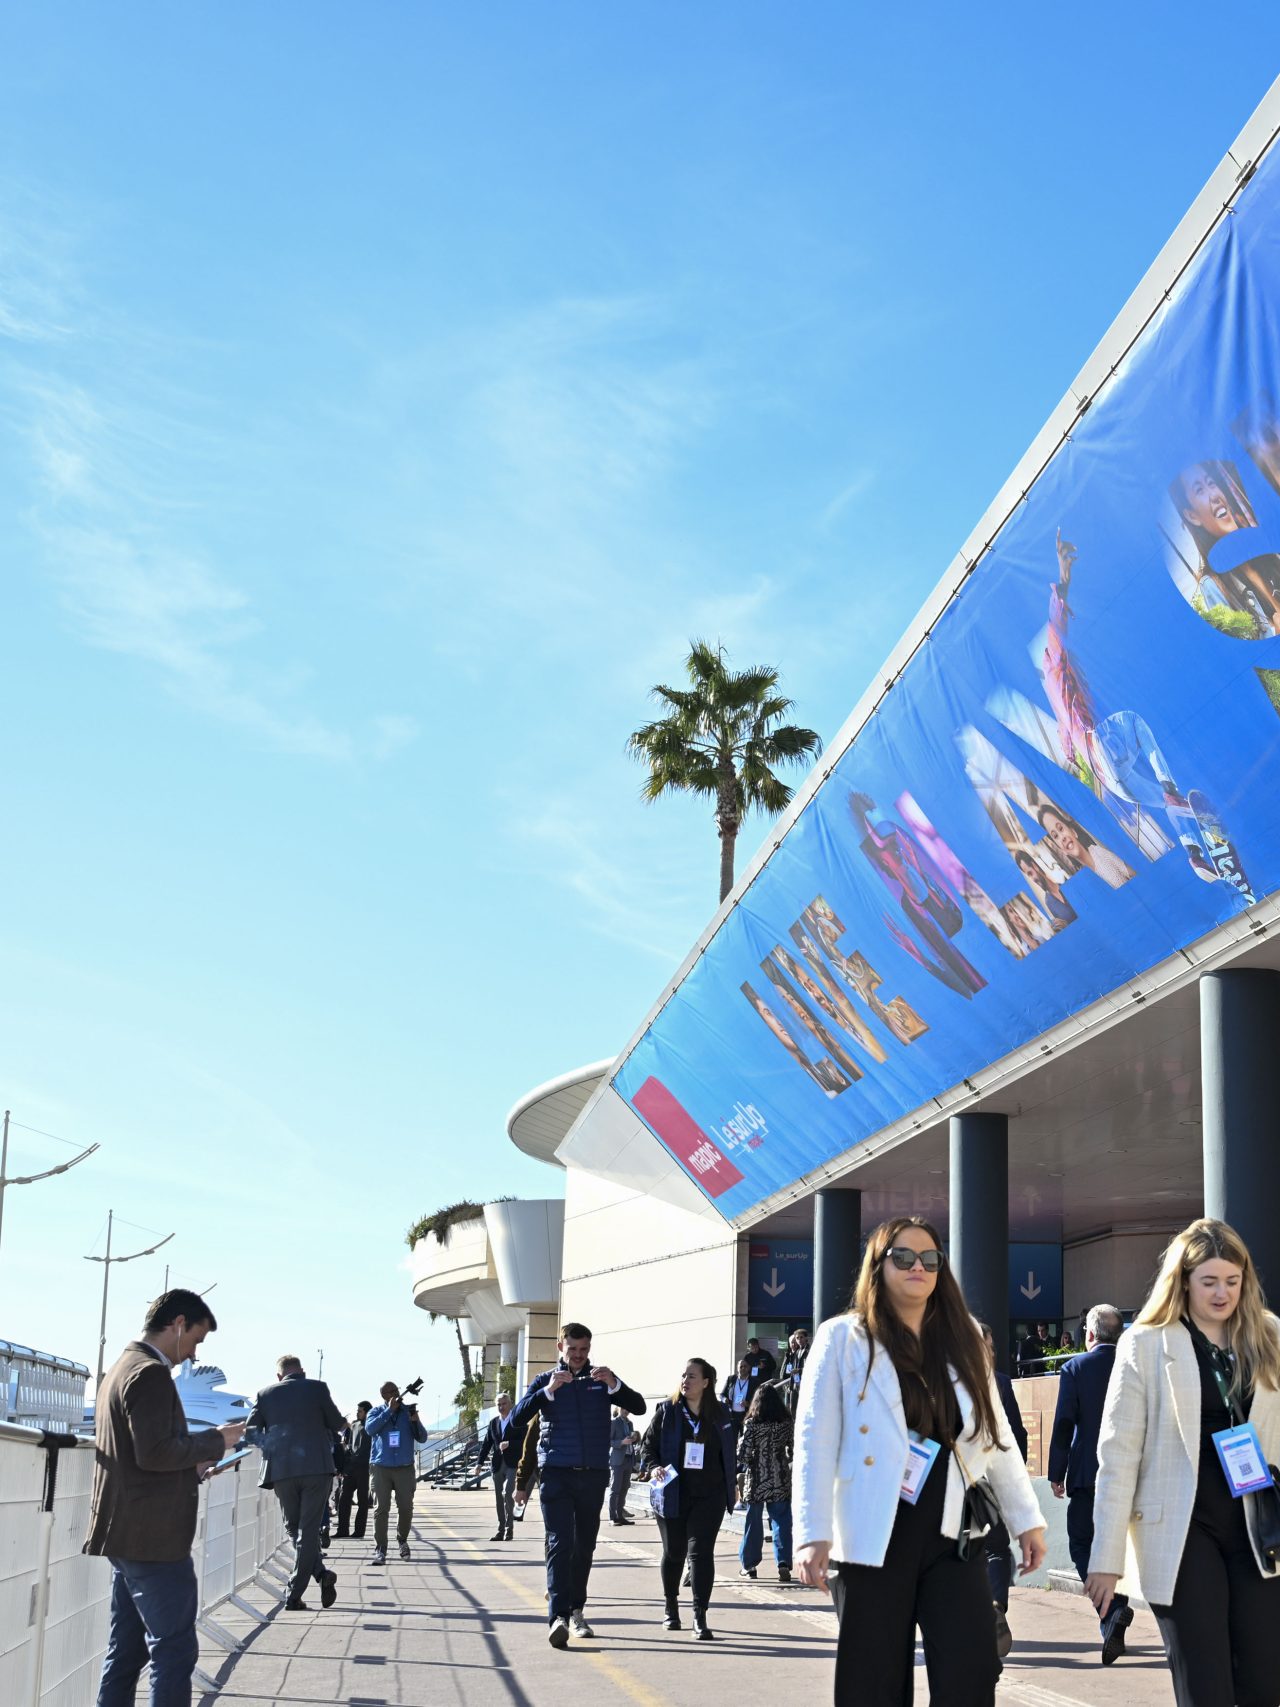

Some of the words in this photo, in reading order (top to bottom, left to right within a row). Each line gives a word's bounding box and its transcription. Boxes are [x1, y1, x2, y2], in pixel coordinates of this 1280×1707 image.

[740, 893, 929, 1100] LIVE
[848, 628, 1178, 999] PLAY
[688, 1139, 722, 1175] mapic
